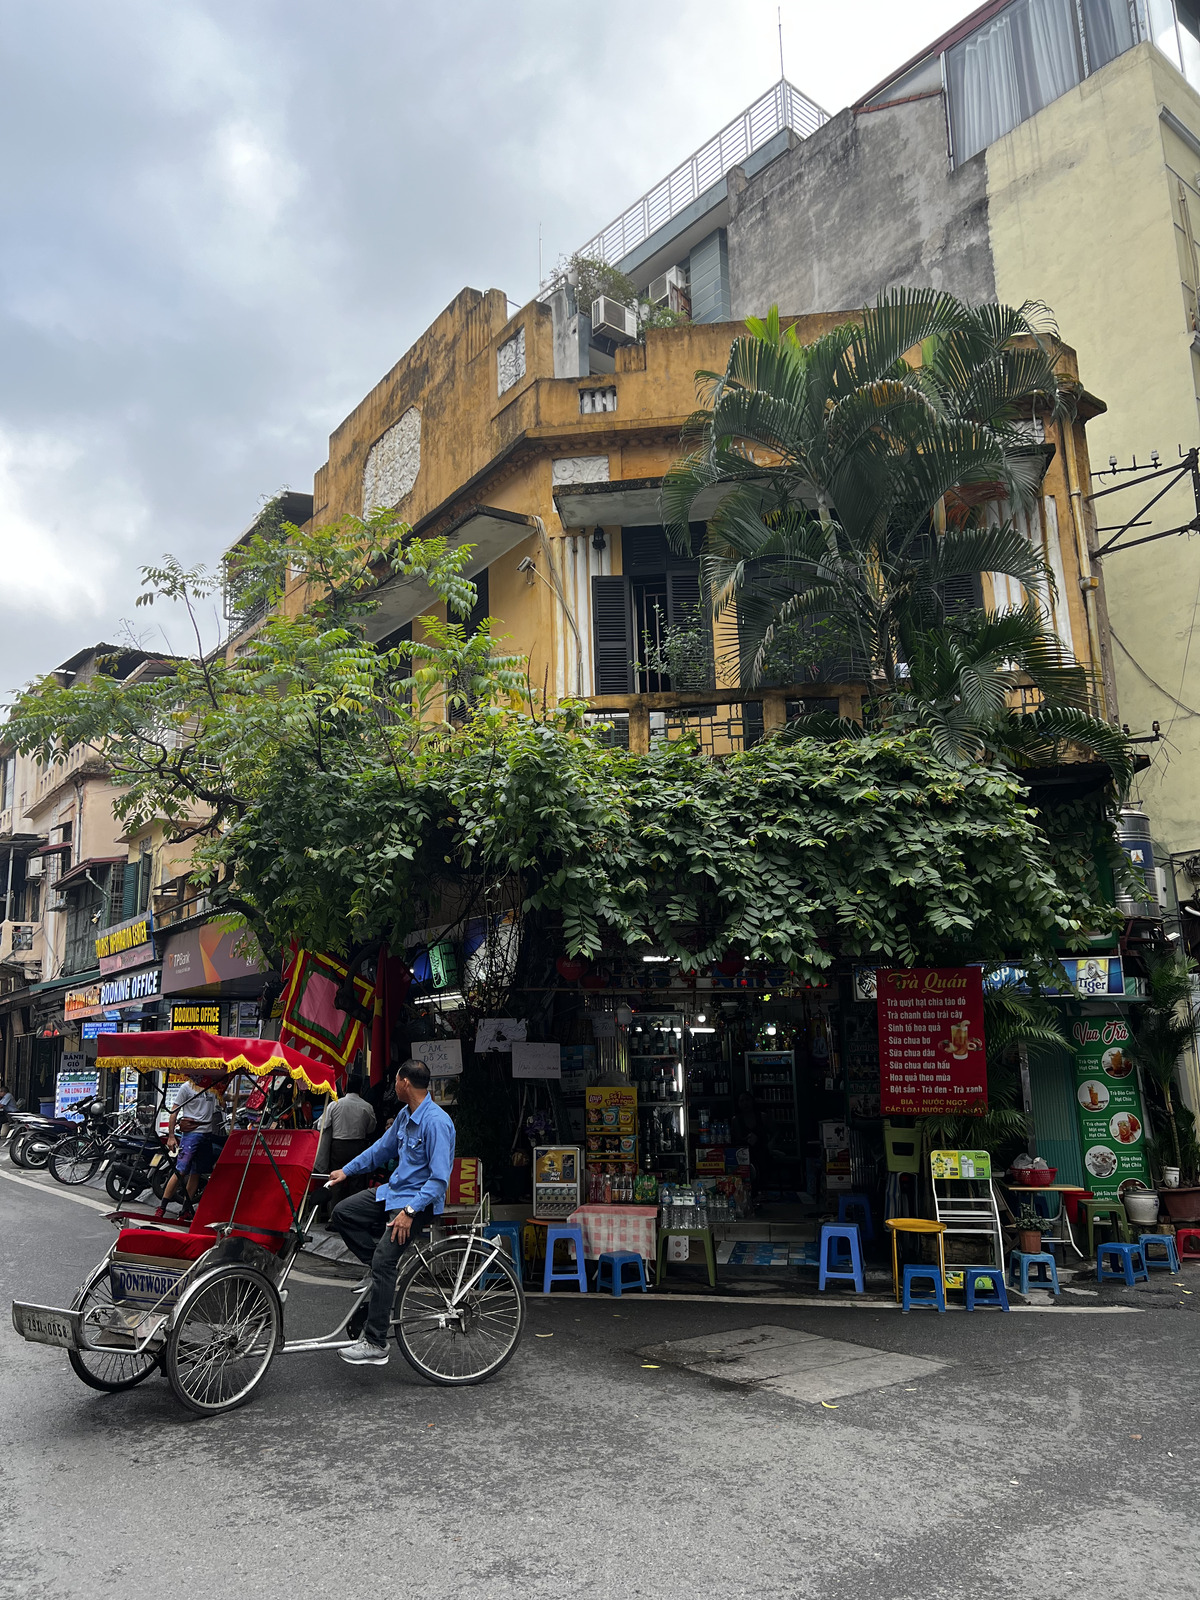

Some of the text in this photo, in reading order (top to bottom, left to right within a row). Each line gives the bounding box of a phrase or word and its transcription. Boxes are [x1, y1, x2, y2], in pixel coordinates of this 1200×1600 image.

[132, 920, 147, 946] CENTER
[174, 951, 190, 967] TPBank
[101, 978, 130, 1005] BOOKING
[132, 970, 158, 998] OFFICE
[887, 971, 918, 990] Trà
[921, 972, 967, 993] Quán
[1079, 978, 1106, 993] Tiger
[887, 998, 899, 1007] Trà
[915, 998, 927, 1008] hạt
[174, 1007, 219, 1022] BOOKING OFFICE
[887, 1011, 898, 1019] Trà
[900, 1011, 921, 1019] chanh
[950, 1010, 962, 1019] cây
[888, 1024, 904, 1032] Sinh
[928, 1022, 941, 1032] quả
[1073, 1020, 1129, 1046] Vua Trà
[64, 1052, 84, 1060] BÁNH
[905, 1072, 917, 1082] quả
[120, 1272, 179, 1296] DONTWORRY
